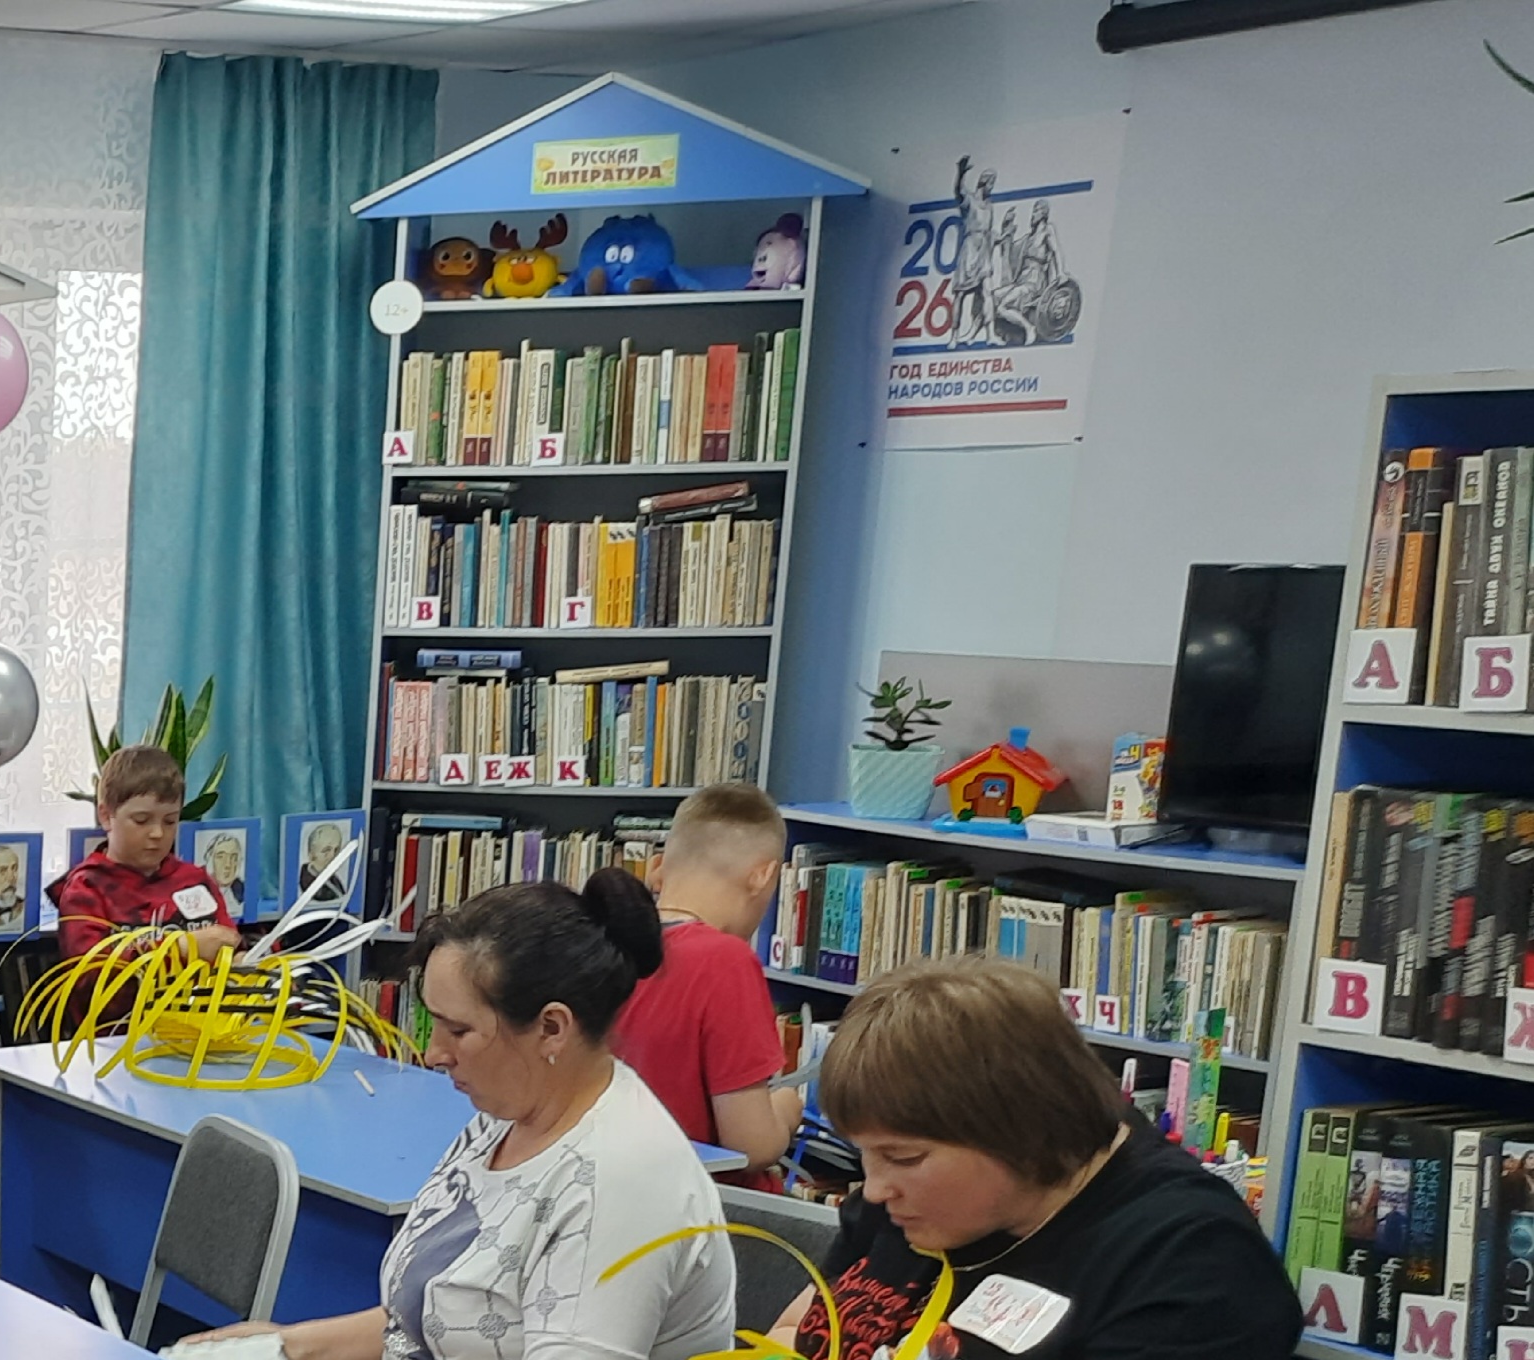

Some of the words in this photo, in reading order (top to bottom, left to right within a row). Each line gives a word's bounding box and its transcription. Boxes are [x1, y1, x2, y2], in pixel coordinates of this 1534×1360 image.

[570, 148, 640, 166] РУССКАЯ
[543, 165, 661, 186] ЛИТЕРАТУРА
[900, 215, 964, 278] 20
[893, 278, 953, 339] 26
[889, 363, 922, 380] ГОД
[928, 357, 1014, 379] ЕДИНСТВА
[887, 380, 964, 400] НАРОДОВ
[967, 376, 1040, 396] РОССИИ
[386, 436, 408, 457] А
[538, 438, 558, 459] Б
[1492, 460, 1512, 529] ОКЕАНОВ
[1487, 533, 1505, 575] ДВУХ
[415, 601, 434, 621] В
[566, 601, 586, 622] Г
[1482, 579, 1499, 627] ТАЙНА
[1352, 639, 1400, 689] А
[1471, 646, 1514, 698] Б
[444, 759, 465, 781] Д
[484, 760, 502, 779] Е
[507, 760, 533, 779] Ж
[558, 760, 580, 780] К
[1328, 970, 1370, 1019] В
[1099, 1000, 1116, 1026] Ч
[1402, 1305, 1458, 1360] М
